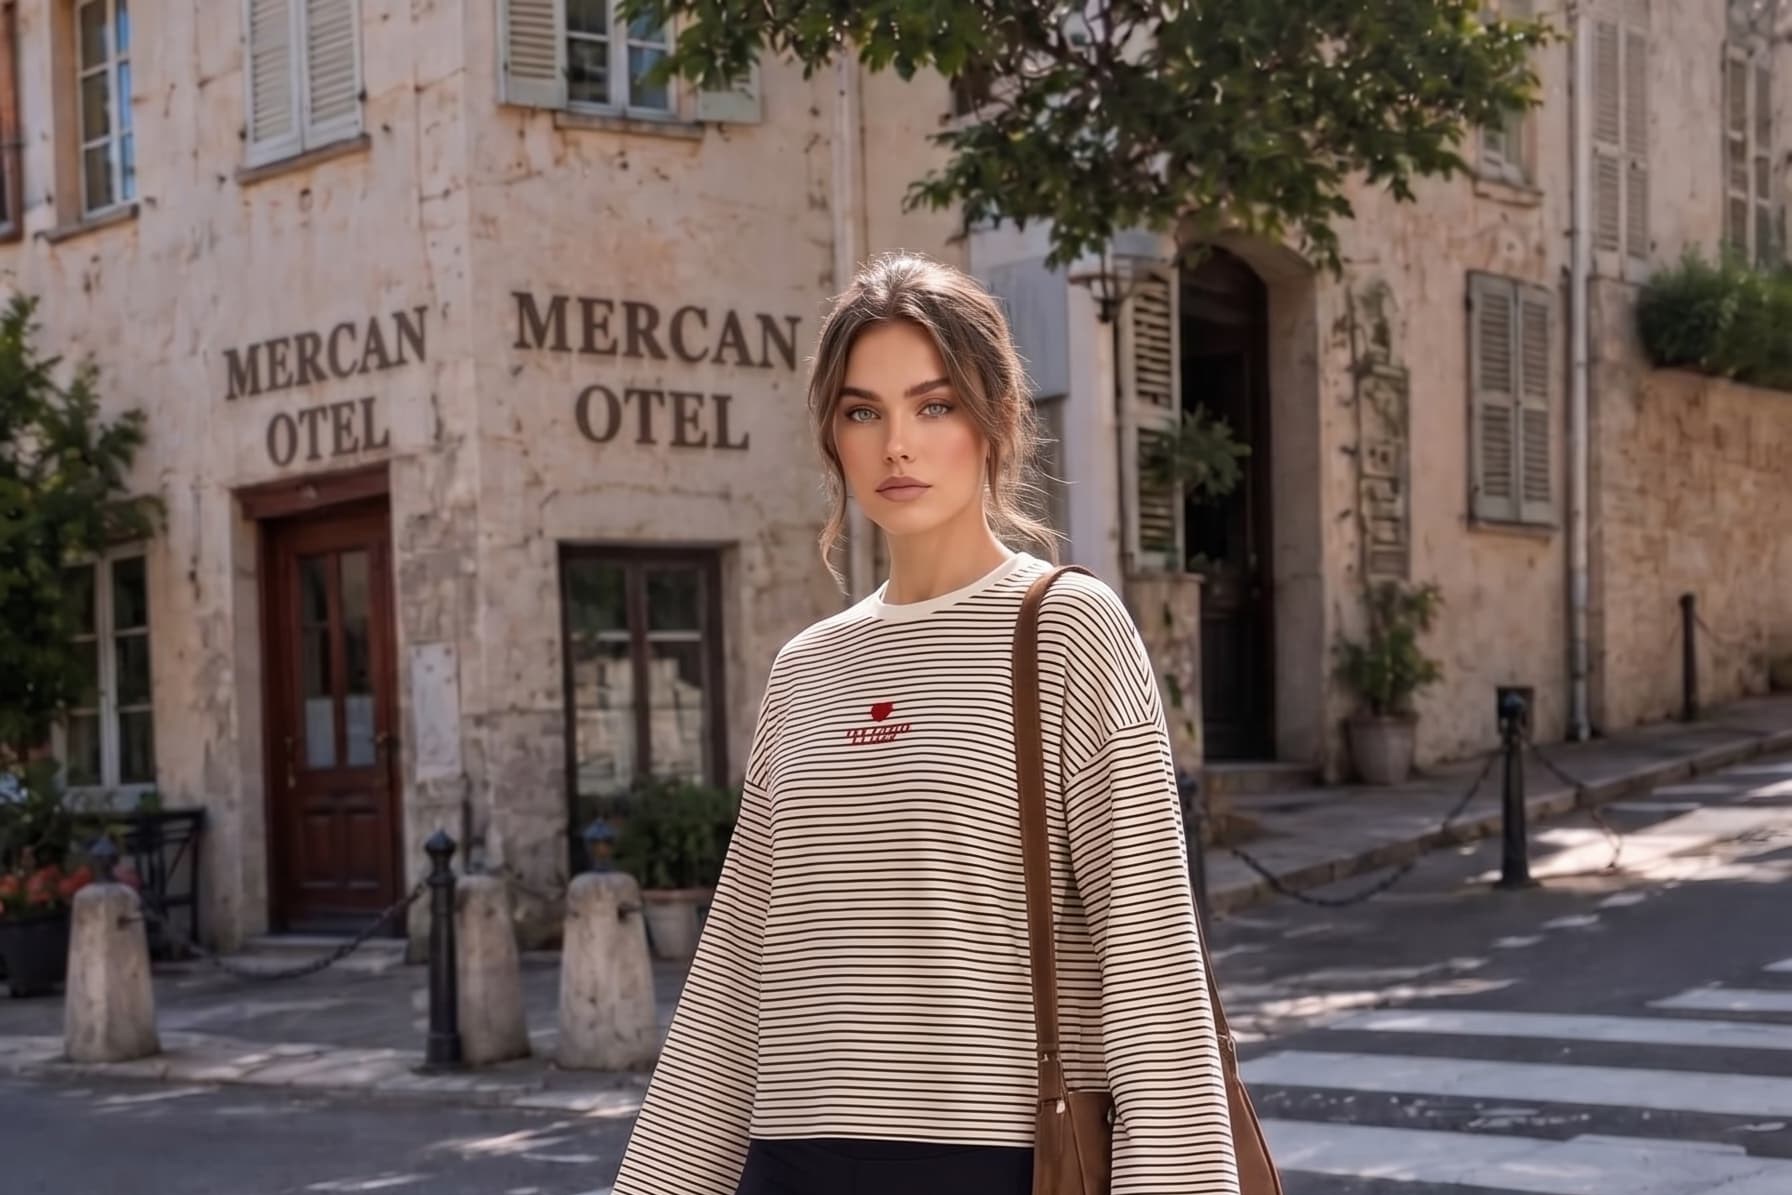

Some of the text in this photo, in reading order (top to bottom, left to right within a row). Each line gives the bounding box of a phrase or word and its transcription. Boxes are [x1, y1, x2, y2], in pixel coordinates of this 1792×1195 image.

[223, 305, 429, 400] MERCAN
[511, 290, 803, 371] MERCAN
[266, 397, 391, 467] OTEL
[574, 384, 750, 451] OTEL
